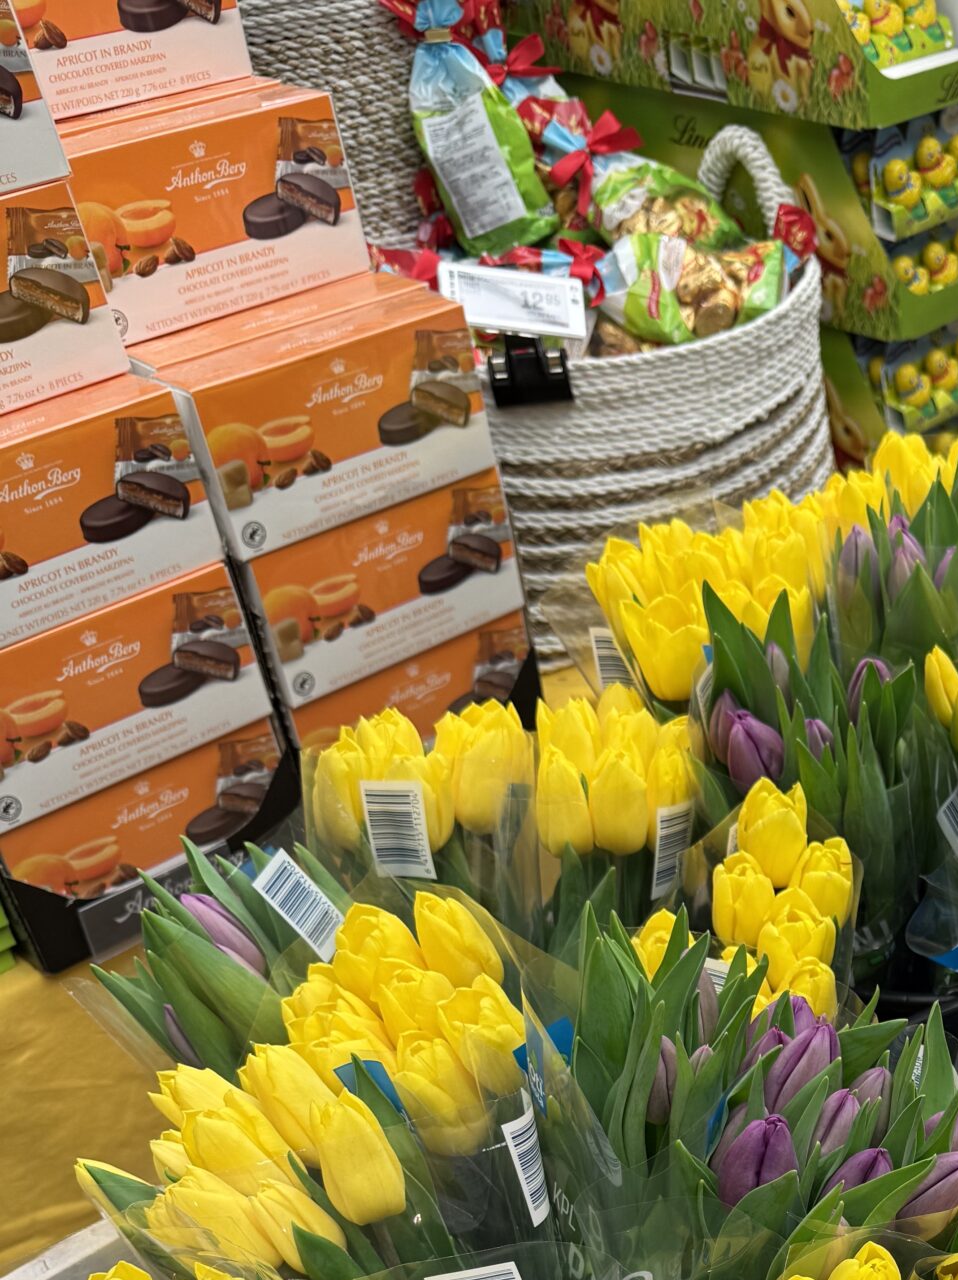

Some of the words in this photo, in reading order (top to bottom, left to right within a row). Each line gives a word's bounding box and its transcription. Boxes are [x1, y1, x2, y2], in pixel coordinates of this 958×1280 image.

[48, 67, 94, 84] CHOCOLATE
[95, 61, 129, 75] COVERED
[130, 53, 167, 68] MARZIPAN
[56, 50, 99, 68] APRICOT
[100, 48, 112, 59] IN
[113, 39, 153, 57] BRANDY
[104, 90, 120, 102] NET
[121, 87, 134, 98] 220
[135, 88, 141, 97] g
[158, 81, 167, 89] oz
[180, 75, 186, 85] 8
[186, 70, 212, 83] PIECES
[669, 114, 710, 149] Lin
[0, 172, 17, 185] CES
[165, 167, 216, 191] Anthon
[210, 159, 247, 182] Berg
[178, 278, 220, 295] CHOCOLATE
[221, 267, 253, 284] COVERED
[254, 257, 289, 273] MARZIPAN
[185, 262, 225, 281] APRICOT
[227, 258, 237, 268] IN
[238, 246, 276, 265] BRANDY
[0, 360, 31, 376] ARZIPAN
[55, 372, 84, 387] PIECES
[306, 384, 353, 408] Anthon
[348, 373, 383, 395] Berg
[0, 480, 46, 503] Anthon
[41, 467, 81, 492] Berg
[321, 467, 359, 489] APRICOT
[373, 451, 408, 469] BRANDY
[11, 585, 58, 609] CHOCOLATE
[59, 571, 95, 591] COVERED
[97, 555, 135, 577] MARZIPAN
[17, 569, 62, 594] APRICOT
[64, 565, 76, 577] IN
[78, 546, 119, 570] BRANDY
[57, 654, 108, 682] Anthon
[102, 640, 141, 665] Berg
[79, 729, 121, 757] APRICOT
[123, 724, 134, 737] IN
[136, 710, 174, 733] BRANDY
[112, 802, 160, 829] Anthon
[154, 787, 189, 809] Berg
